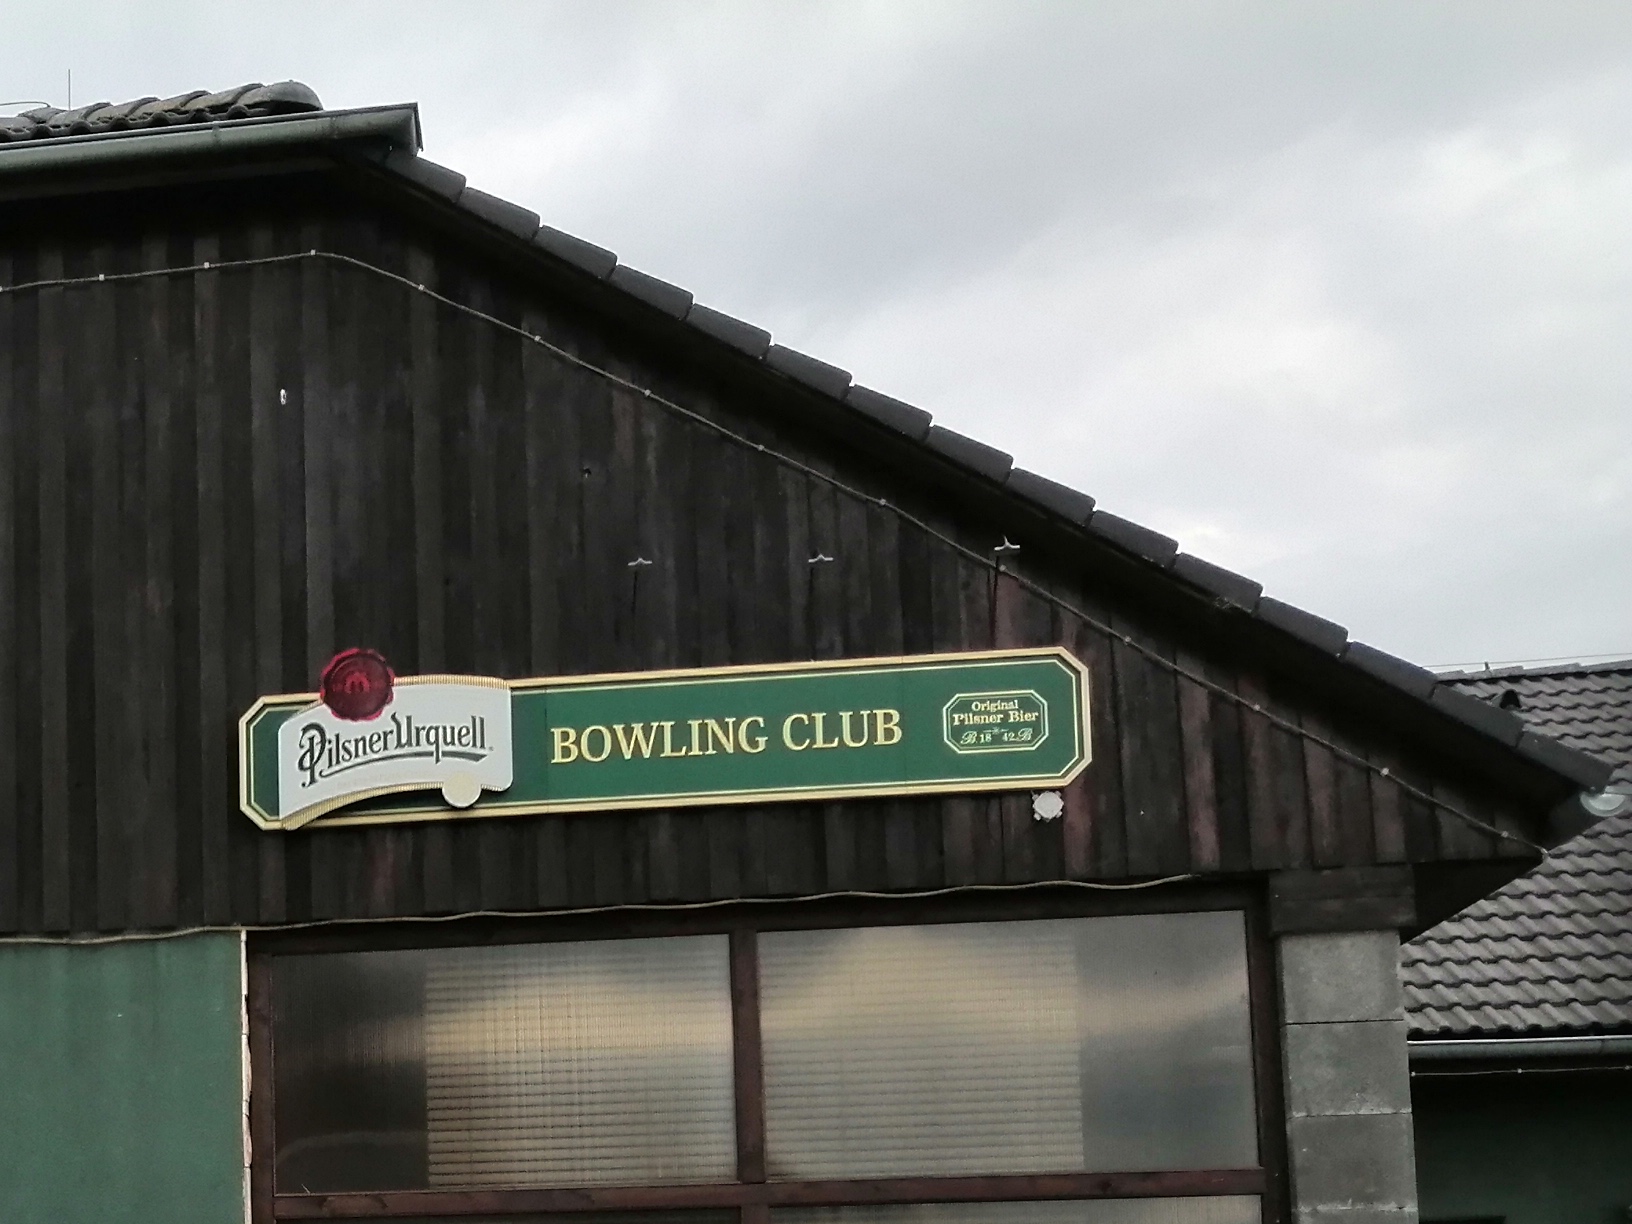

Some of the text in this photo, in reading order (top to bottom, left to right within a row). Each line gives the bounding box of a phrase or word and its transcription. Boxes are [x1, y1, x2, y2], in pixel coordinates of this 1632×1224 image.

[971, 699, 1019, 713] Original
[952, 709, 1039, 726] Pilsner Bier
[550, 708, 903, 764] BOWLING CLUB
